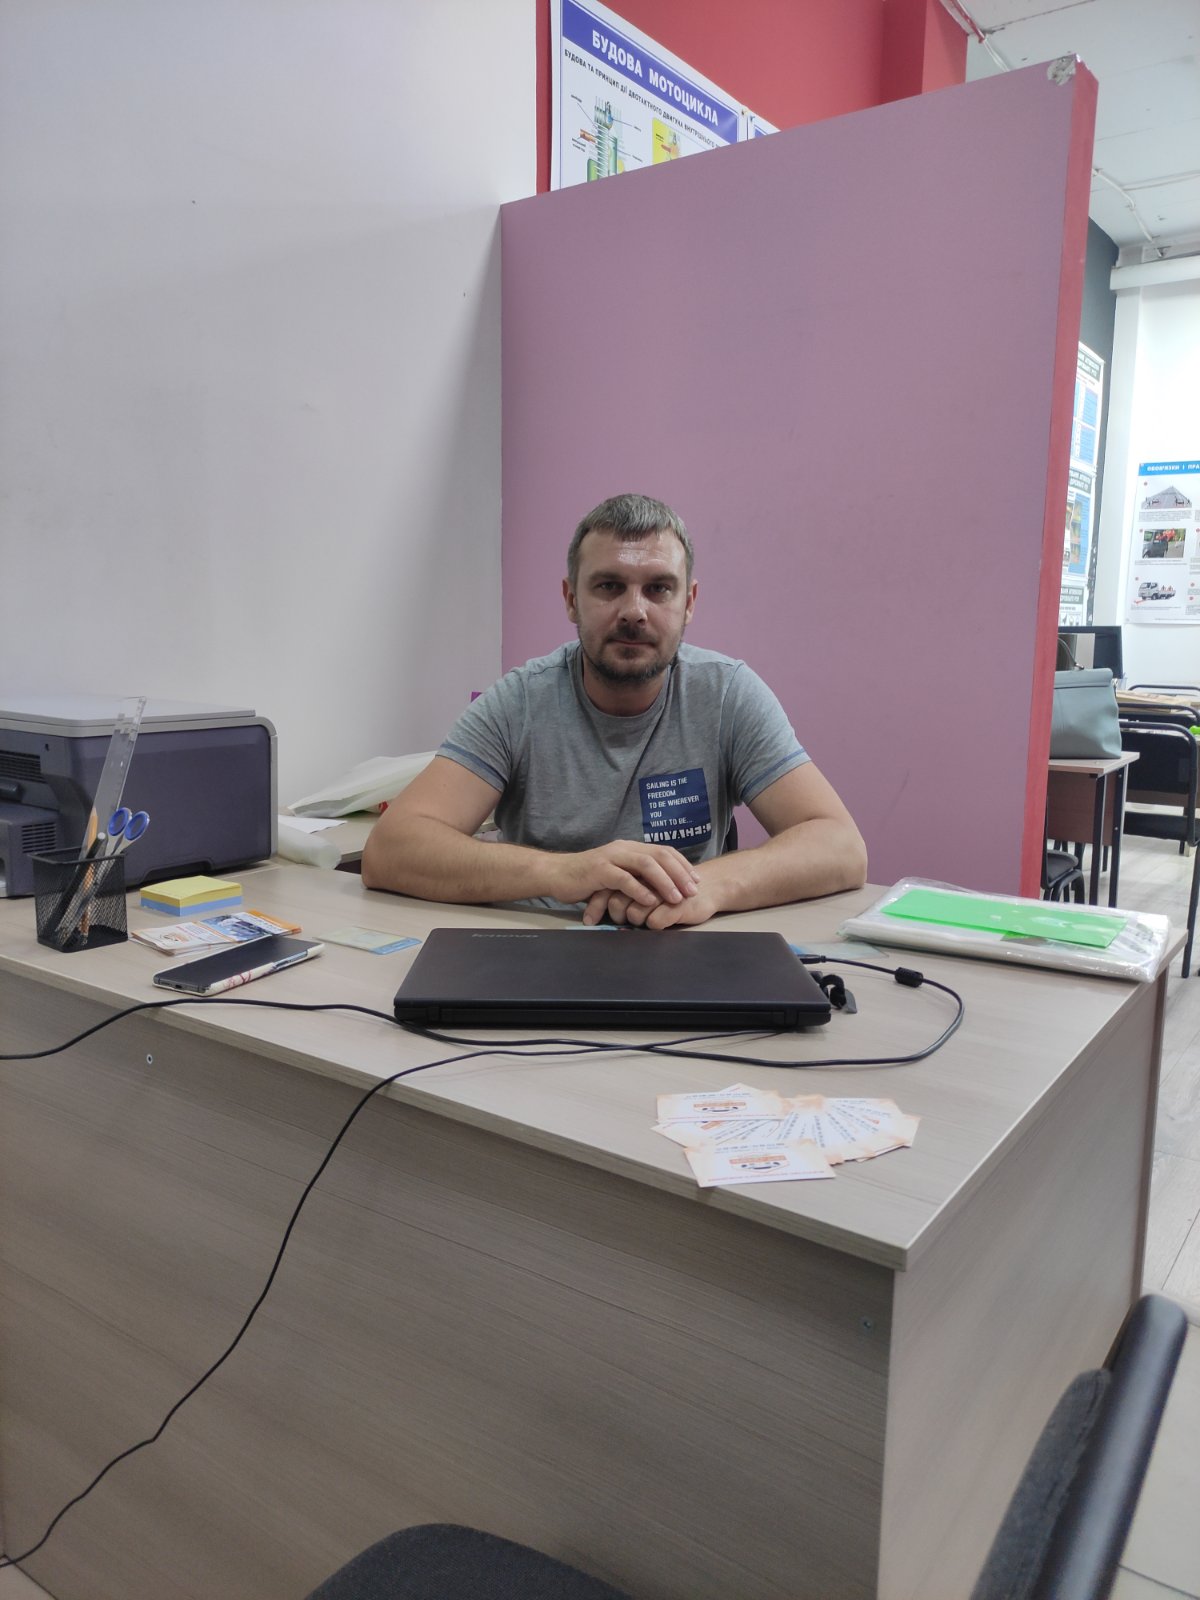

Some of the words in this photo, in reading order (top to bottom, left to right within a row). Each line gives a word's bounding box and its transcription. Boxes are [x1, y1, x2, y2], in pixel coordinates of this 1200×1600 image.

[564, 49, 587, 68] БУДОВА
[588, 63, 595, 73] ТА
[595, 68, 619, 88] ПРИНЦИП
[592, 29, 643, 78] БУДОВА
[649, 68, 719, 126] МОТОЦИКЛА
[646, 780, 670, 790] SAILING
[647, 789, 676, 799] FREEDOM
[658, 800, 666, 808] BE
[667, 795, 699, 806] WHEREVER
[650, 819, 667, 828] WANT
[669, 818, 677, 826] TO
